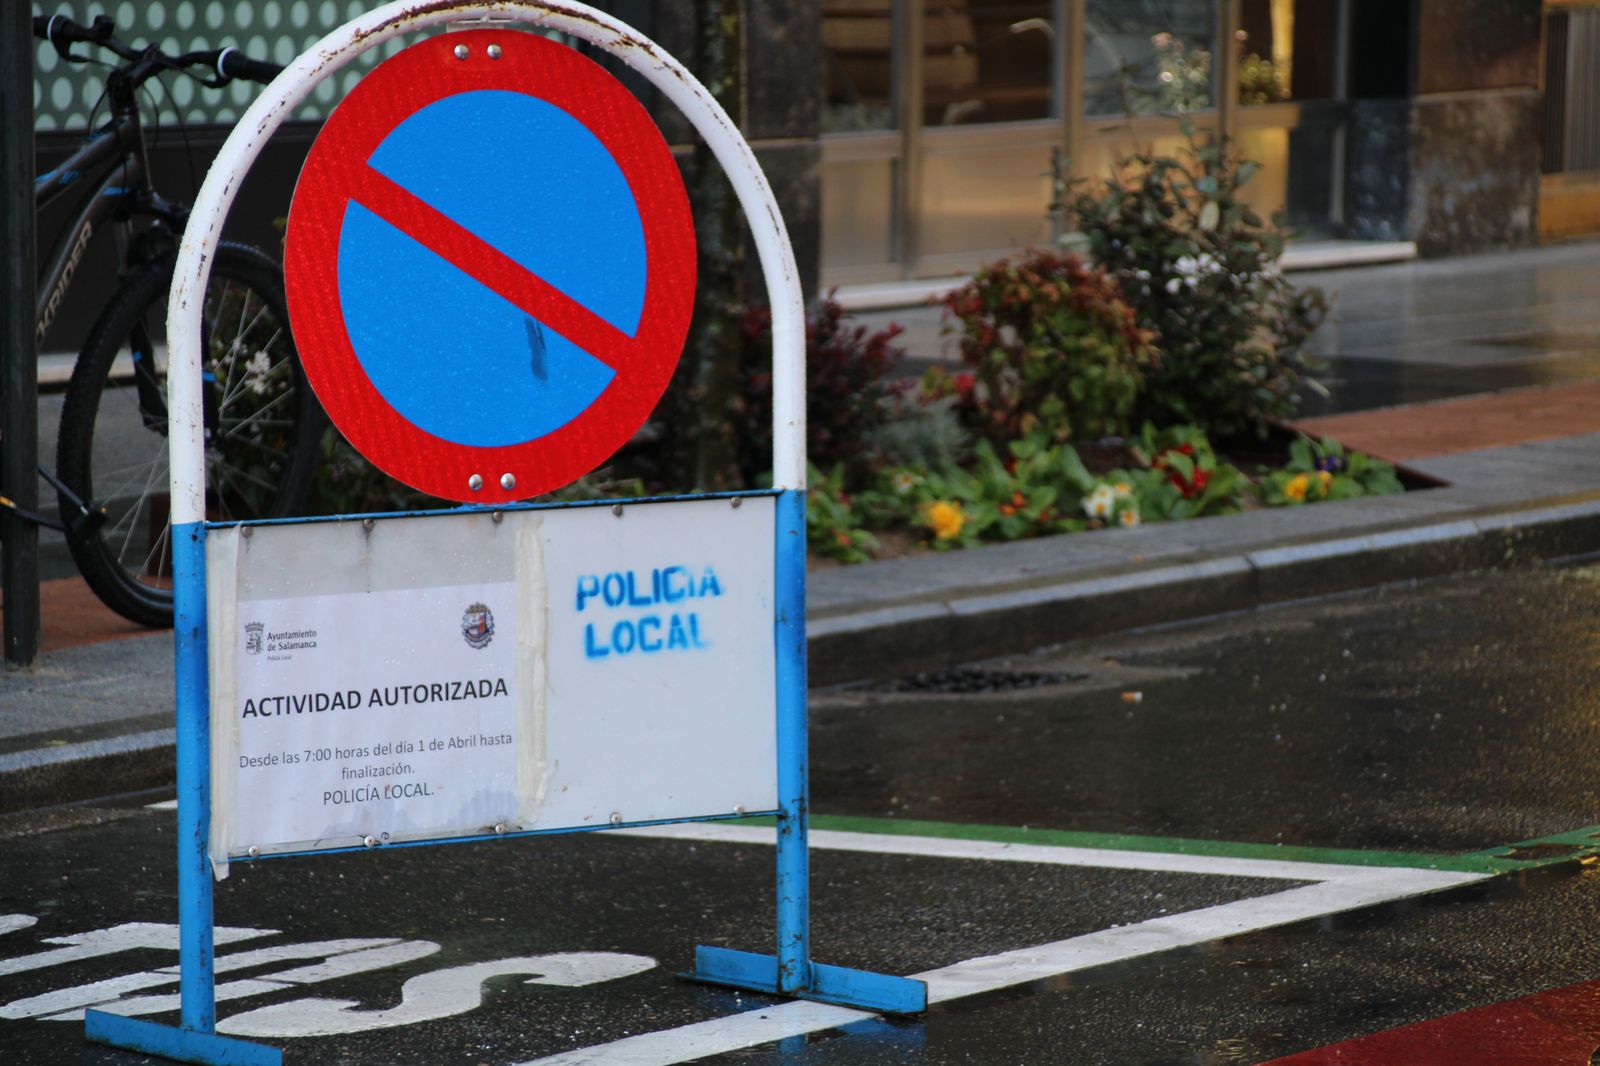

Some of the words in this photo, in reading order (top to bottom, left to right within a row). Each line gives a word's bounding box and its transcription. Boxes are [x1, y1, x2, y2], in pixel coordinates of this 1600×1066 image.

[36, 221, 92, 337] KRIDER
[576, 565, 722, 611] POLICIA
[267, 629, 317, 642] Ayuntamiento
[278, 641, 317, 650] Salamanca
[585, 613, 710, 658] LOCAL
[242, 690, 361, 718] ACTIVIDAD
[368, 678, 508, 708] AUTORIZADA
[239, 753, 279, 768] Desde
[282, 752, 300, 764] las
[304, 748, 331, 762] 7:00
[335, 747, 369, 759] horas
[373, 742, 392, 756] del
[419, 740, 425, 752] 1
[429, 738, 445, 750] de
[448, 735, 476, 749] Abril
[480, 734, 512, 746] hasta
[342, 763, 415, 780] finalización.
[323, 784, 380, 805] POLICÍA
[384, 783, 434, 799] LOCAL.
[0, 914, 657, 1037] TOS
